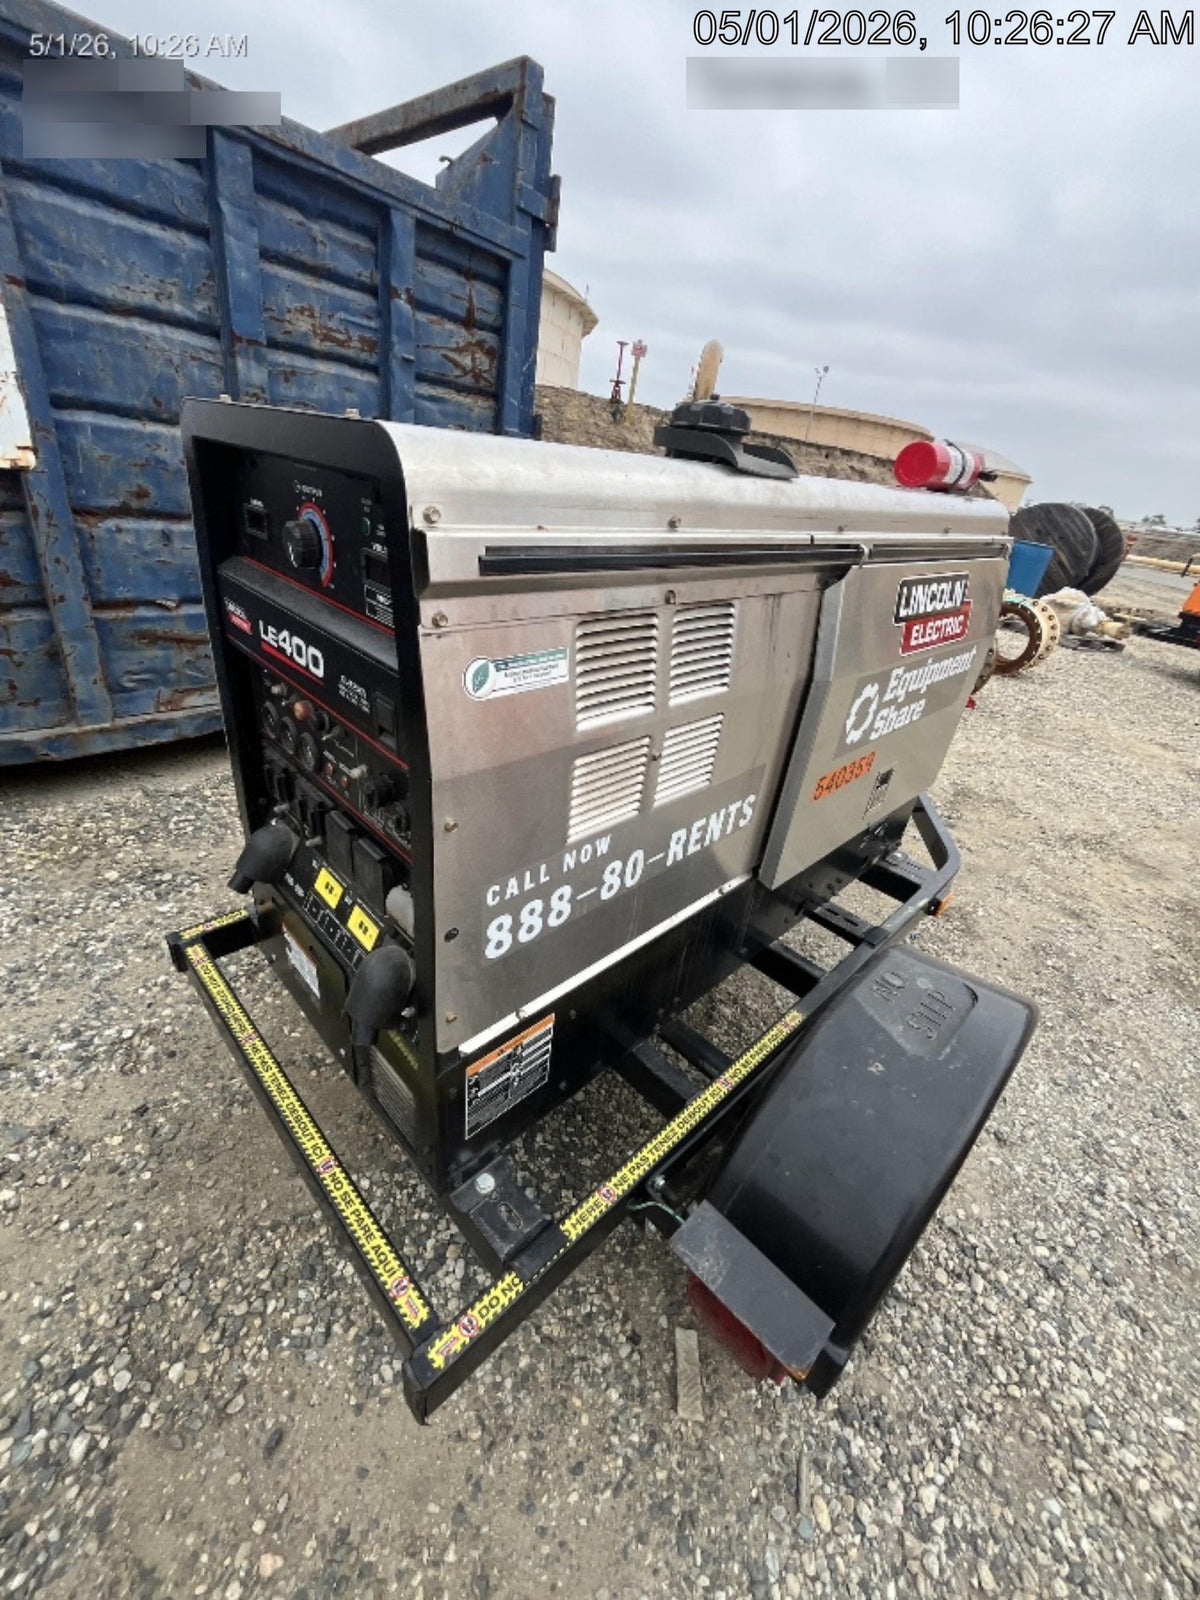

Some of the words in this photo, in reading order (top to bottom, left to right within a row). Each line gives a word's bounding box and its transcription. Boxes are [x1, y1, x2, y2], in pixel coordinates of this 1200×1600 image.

[899, 579, 967, 618] LINCOLN
[258, 619, 325, 679] LE400
[909, 614, 965, 647] ELECTRIC
[882, 645, 978, 703] Equipment
[868, 698, 927, 741] Share
[484, 794, 757, 960] 888-80-RENTS
[486, 863, 550, 907] CALL
[562, 832, 613, 873] NOW
[268, 1072, 290, 1104] TENEZ
[286, 1101, 315, 1143] DEBOUT
[310, 1142, 325, 1160] ICI
[613, 1172, 630, 1190] NE
[628, 1154, 650, 1176] PAS
[646, 1127, 679, 1157] TENEZ
[676, 1097, 711, 1130] DEBOUT
[328, 1170, 344, 1191] NO
[340, 1190, 356, 1209] SE
[350, 1208, 376, 1245] PARE
[569, 1198, 604, 1231] HERE
[477, 1296, 500, 1320] DO
